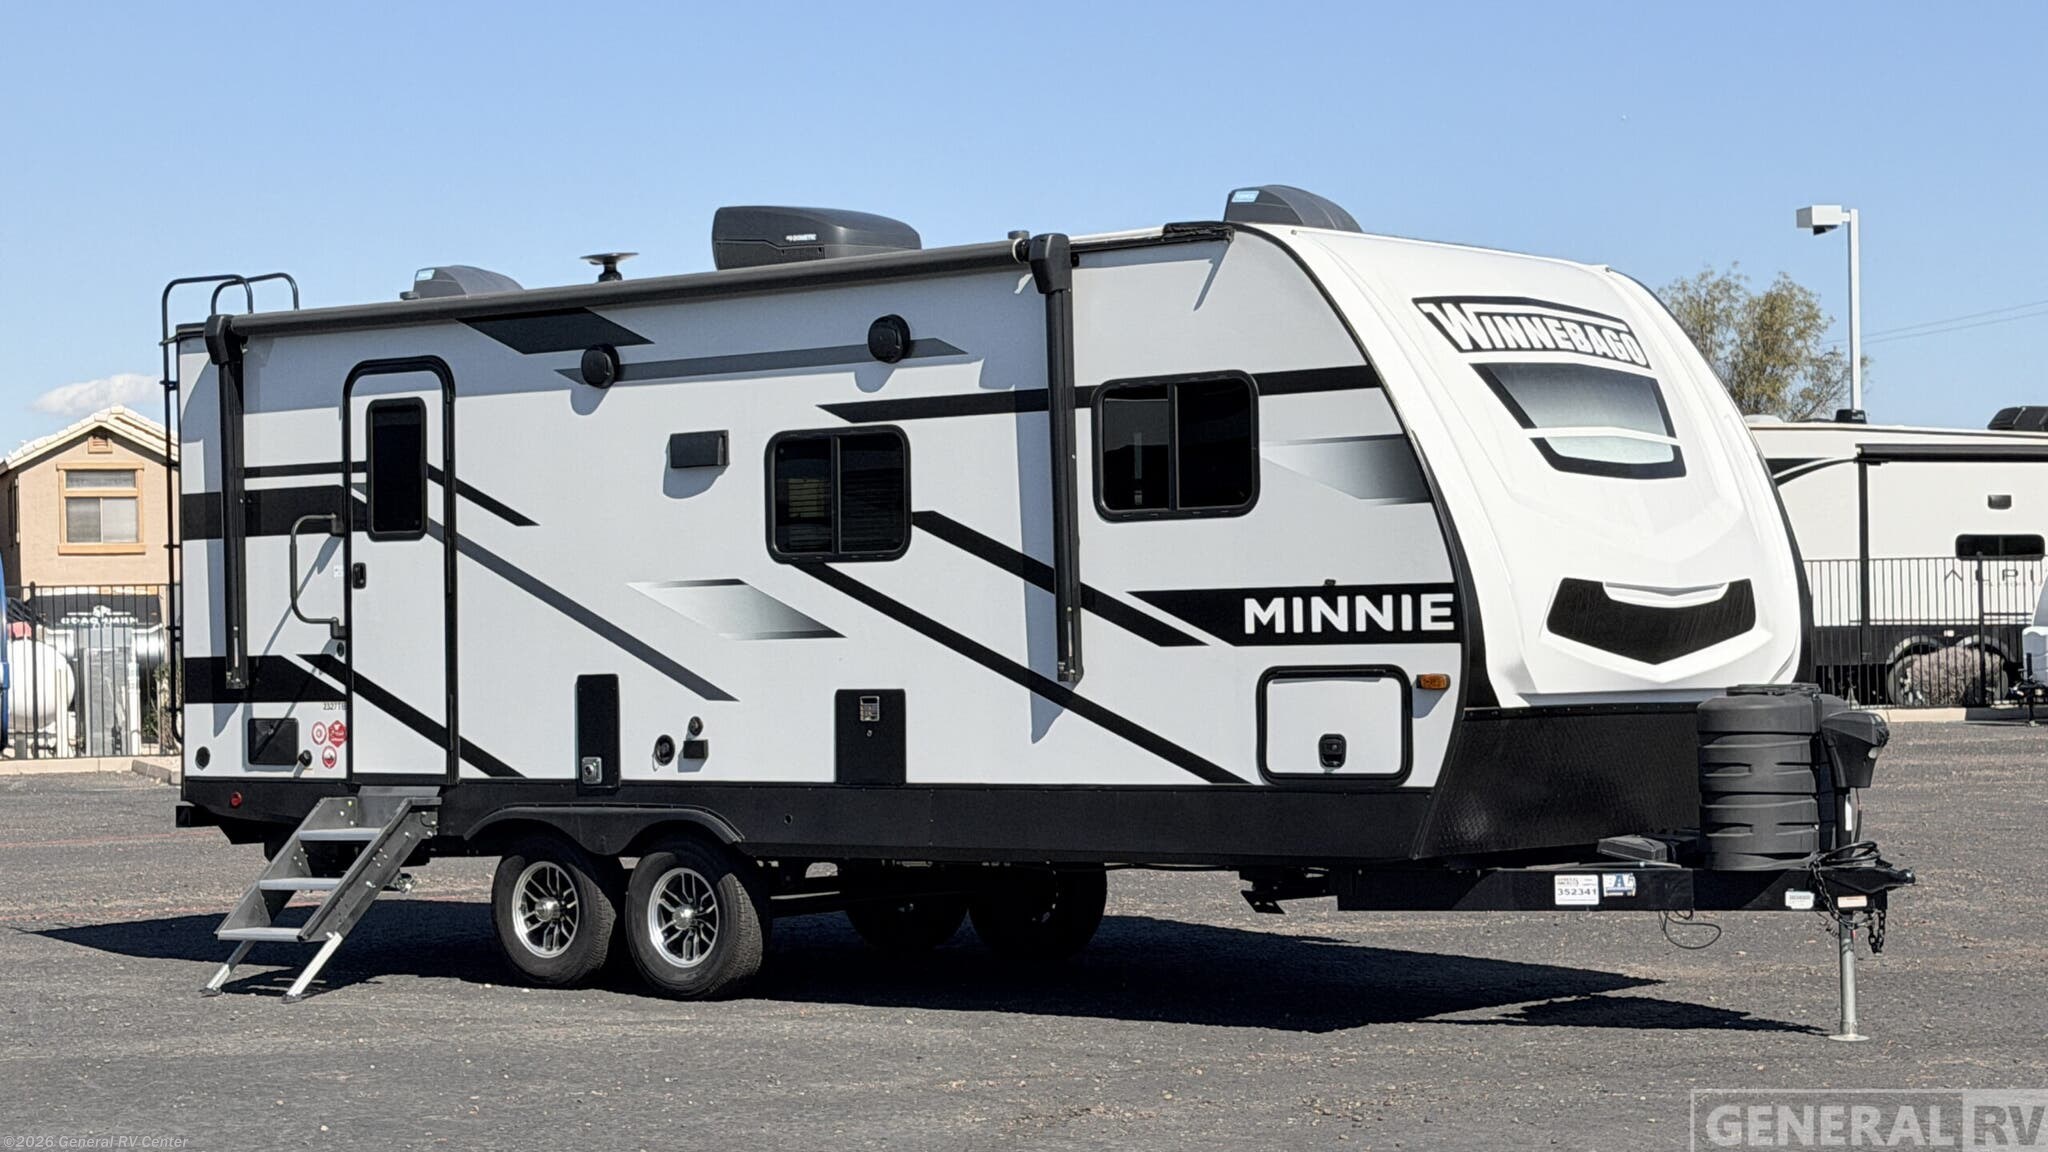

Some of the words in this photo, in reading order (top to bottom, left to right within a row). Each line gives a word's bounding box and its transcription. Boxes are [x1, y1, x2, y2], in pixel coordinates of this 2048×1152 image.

[1416, 302, 1648, 367] WINNEBAGO
[1244, 593, 1455, 635] MINNIE
[1557, 888, 1597, 896] 352341
